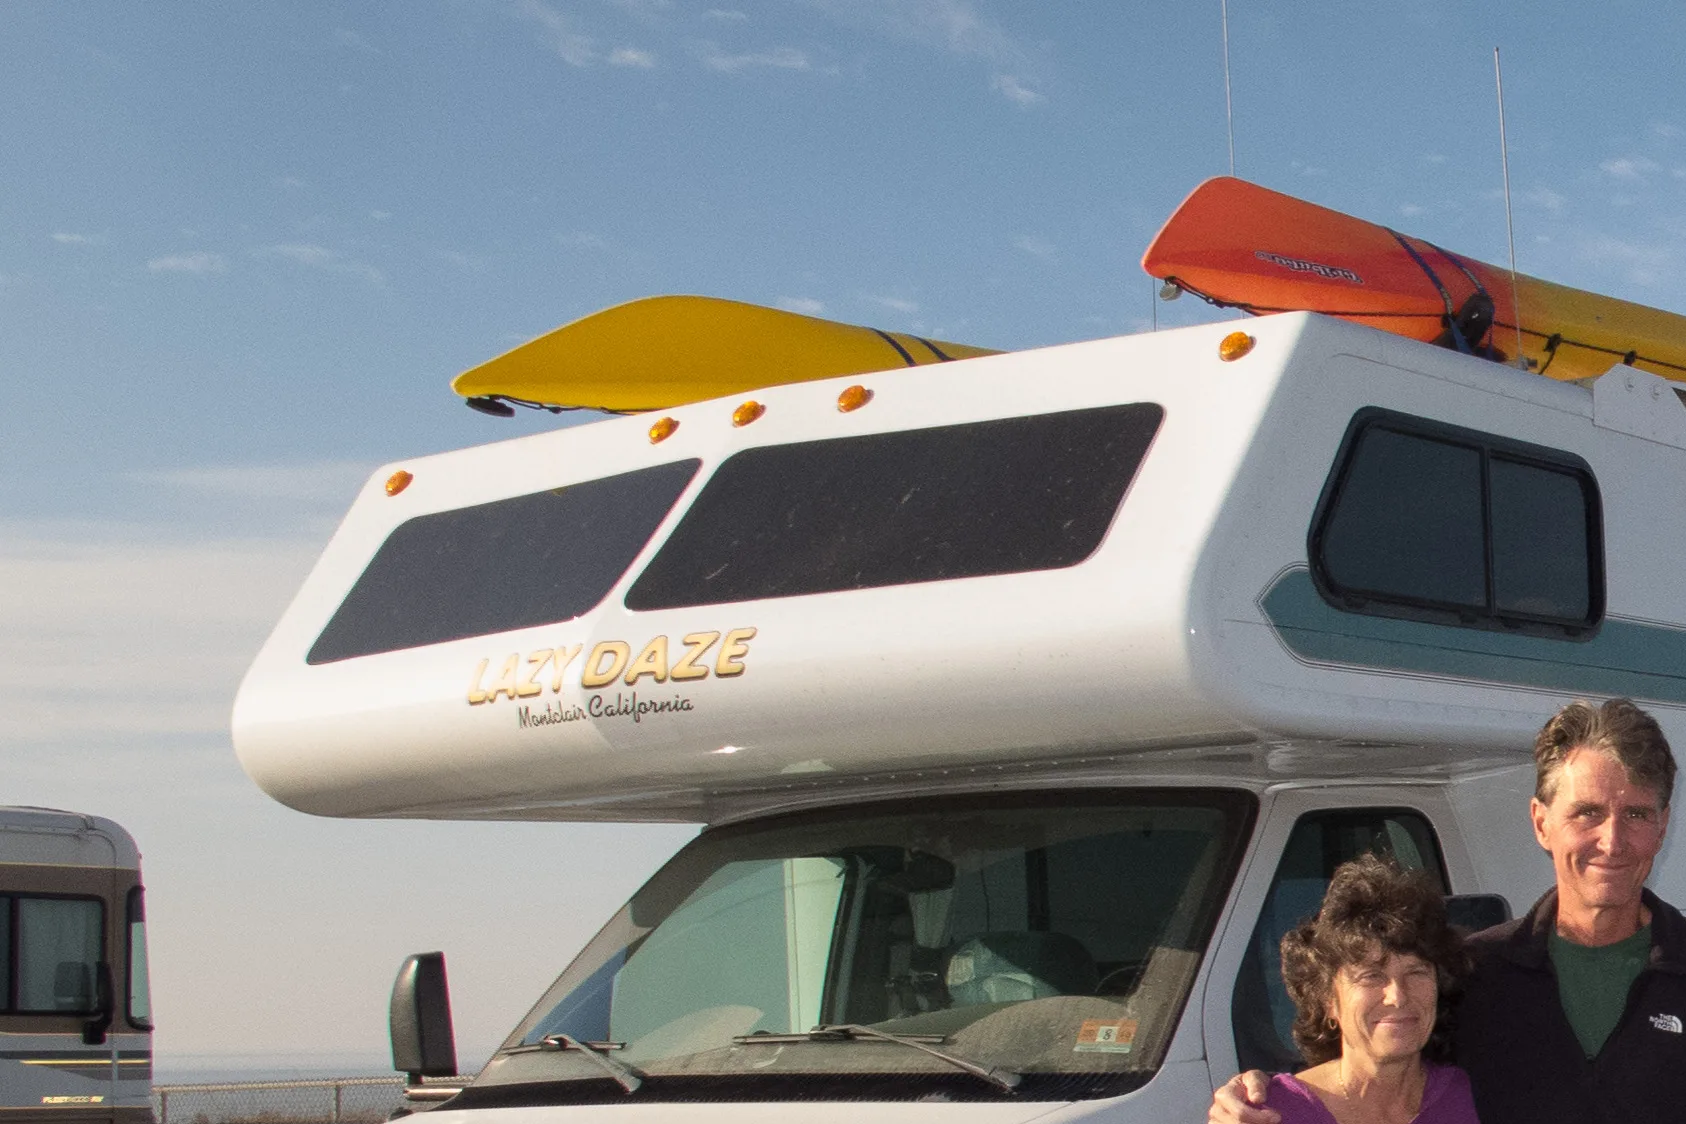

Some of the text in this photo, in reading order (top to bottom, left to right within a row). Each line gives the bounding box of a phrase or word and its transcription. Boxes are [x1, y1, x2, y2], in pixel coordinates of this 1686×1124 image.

[467, 626, 757, 705] LAZY DAZE
[588, 692, 694, 724] California
